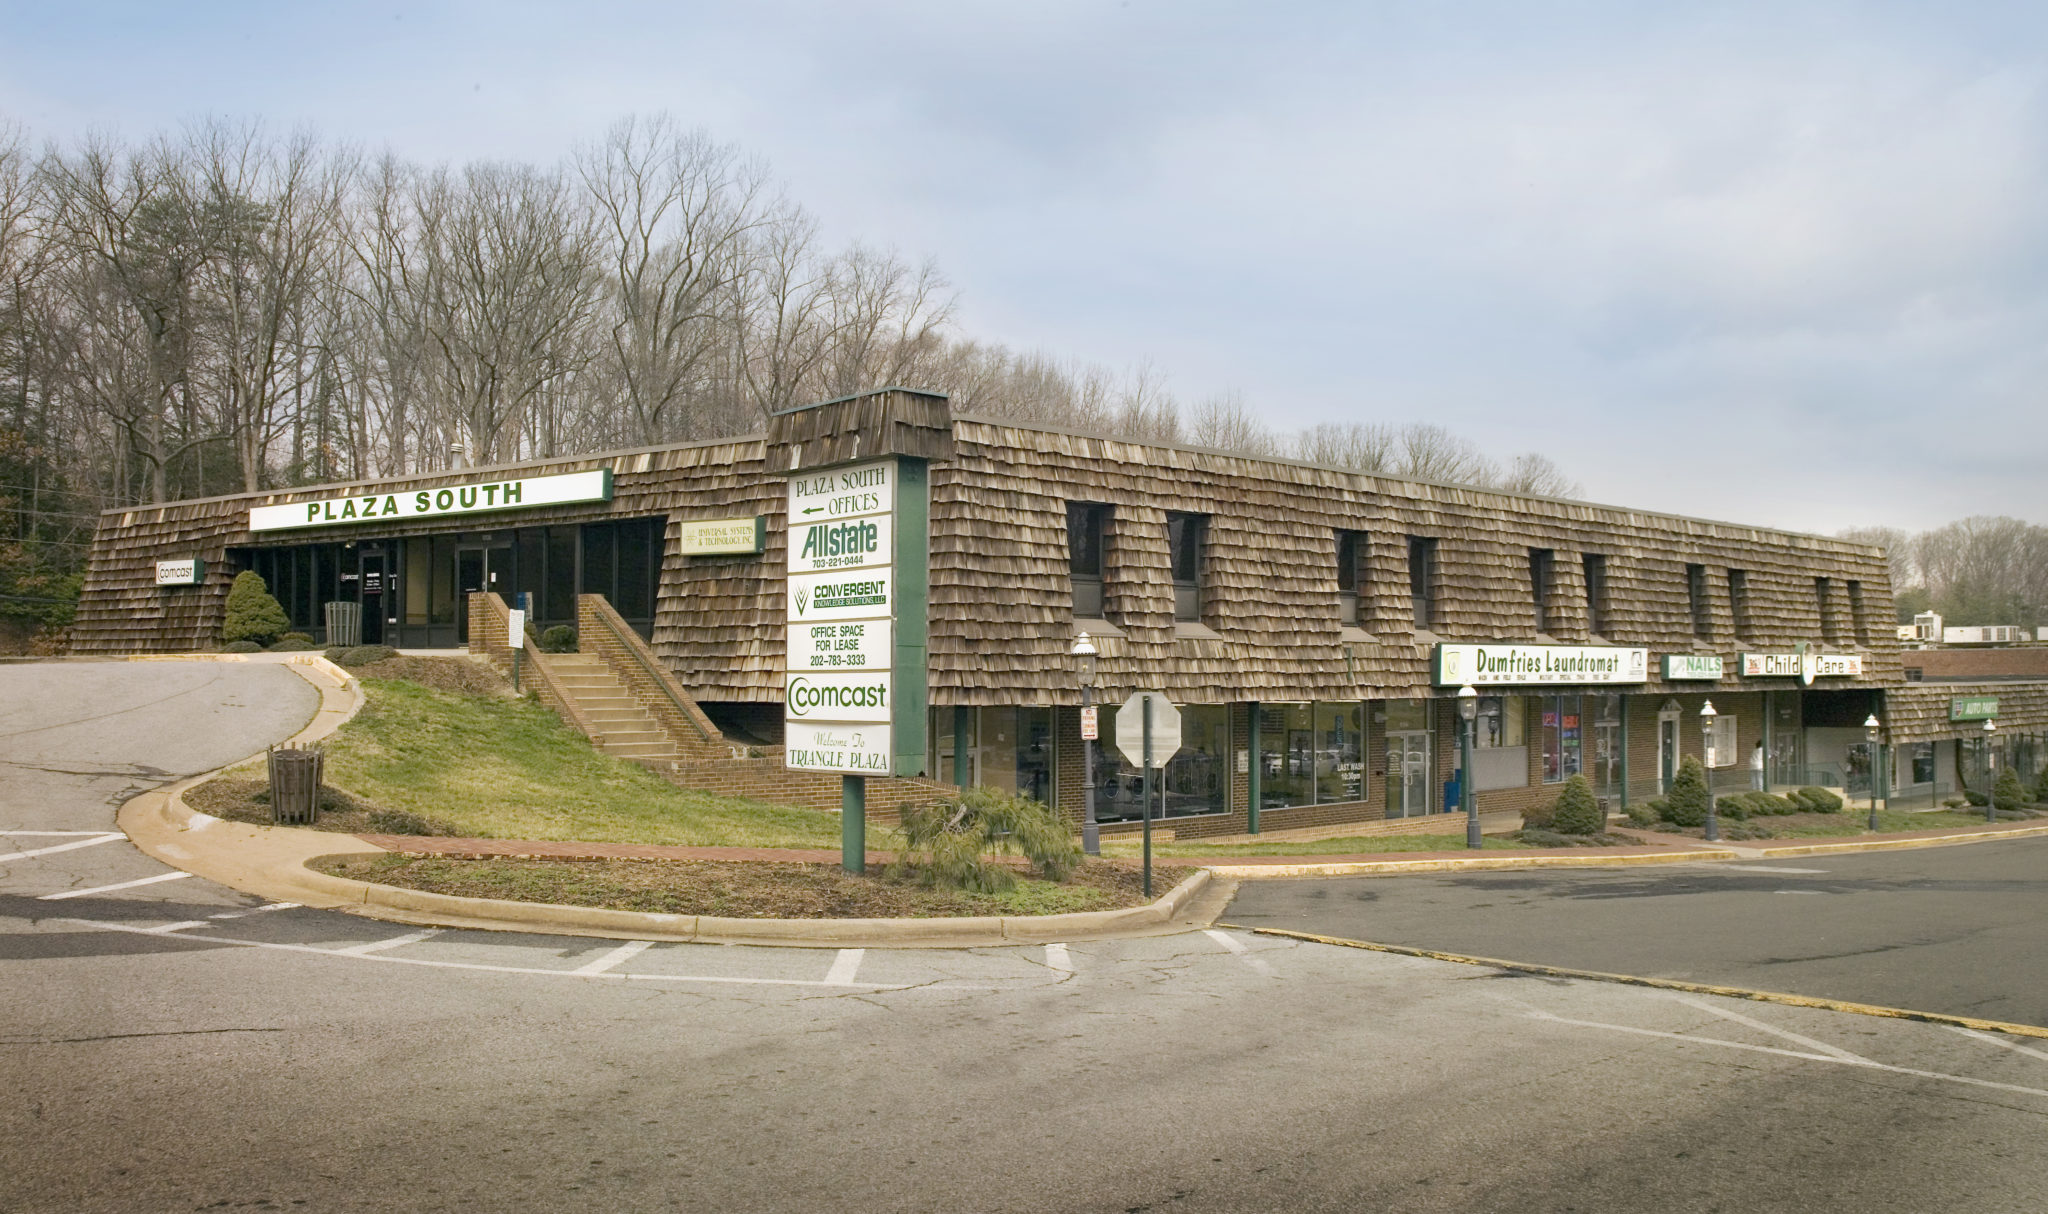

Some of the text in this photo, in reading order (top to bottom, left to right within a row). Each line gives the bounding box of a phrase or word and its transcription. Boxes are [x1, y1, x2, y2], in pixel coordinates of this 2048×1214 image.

[796, 467, 885, 497] PLAZA SOUTH
[307, 481, 522, 522] PLAZA SOUTH
[829, 492, 879, 515] OFFICES
[698, 526, 754, 536] UNIVERSAL SYSTEMS
[801, 520, 878, 559] Allstate
[812, 555, 864, 569] 703-221-0444
[814, 581, 885, 598] CONVERGENT
[814, 599, 845, 608] KNOWLEDGE
[875, 595, 885, 604] LLC
[811, 625, 865, 638] OFFICE SPACE
[816, 639, 859, 652] FOR LEASE
[810, 654, 866, 666] 202-783-3333
[1477, 648, 1619, 673] Dumfries Laundromat
[1687, 656, 1722, 671] NAILS
[1765, 655, 1800, 674] Child
[1816, 656, 1844, 673] Care
[1965, 702, 1981, 714] AUTO
[1981, 701, 1998, 714] PARTS
[814, 731, 865, 748] Welcome To
[790, 749, 887, 770] TRIANGLE PLAZA
[1337, 762, 1364, 771] LAST WASH
